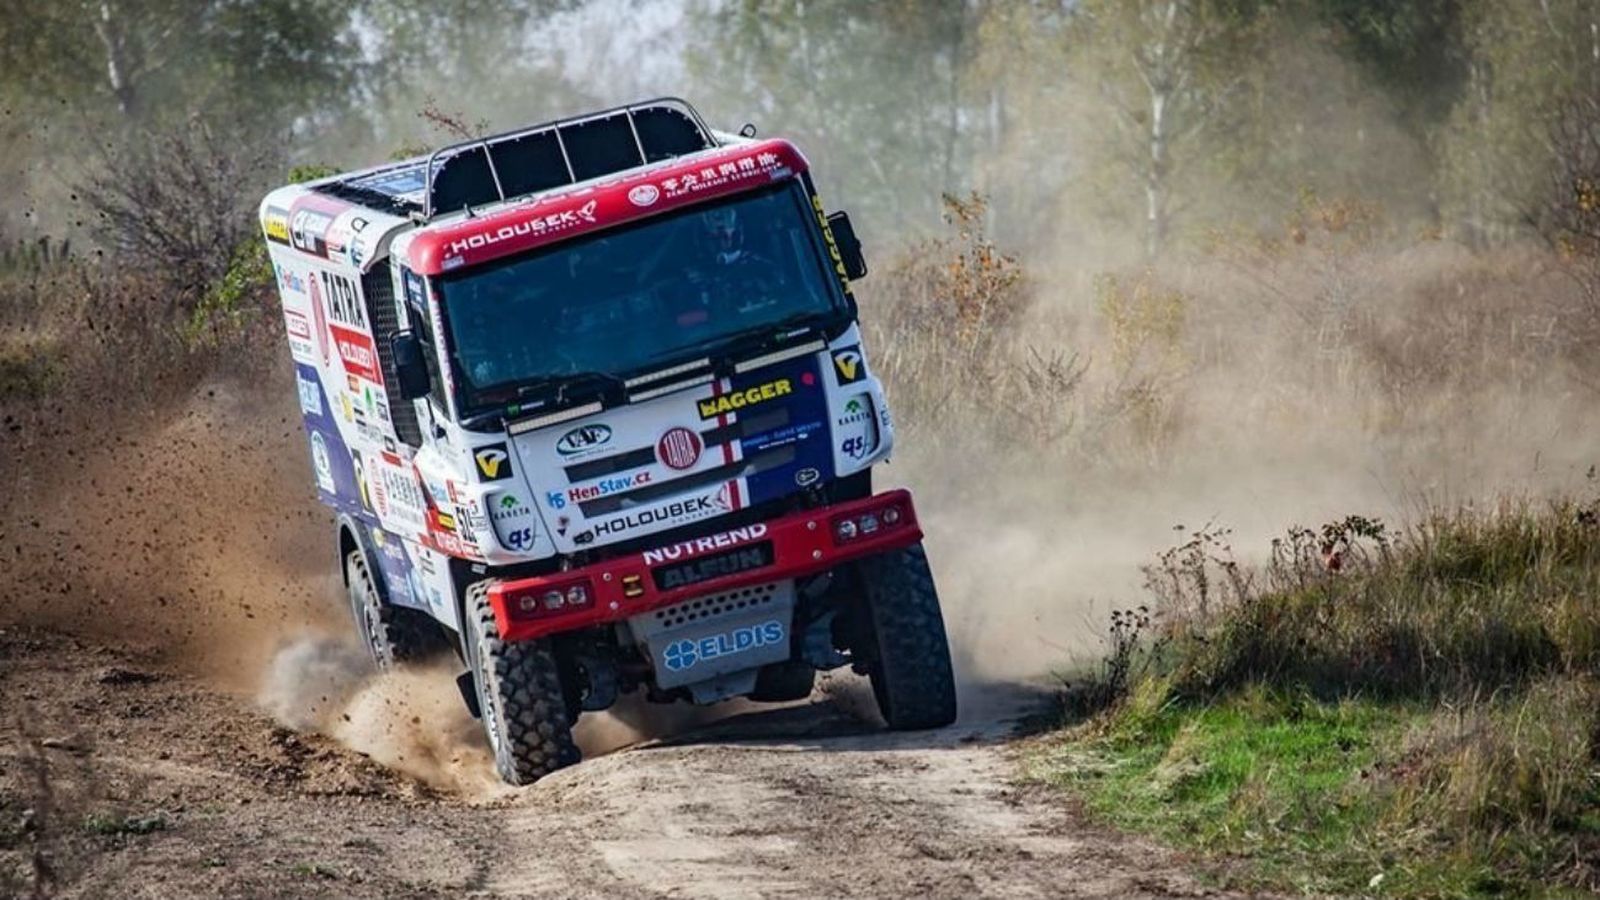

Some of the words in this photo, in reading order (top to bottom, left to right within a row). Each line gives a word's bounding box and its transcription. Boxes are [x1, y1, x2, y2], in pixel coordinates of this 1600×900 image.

[451, 210, 577, 253] HOLOUBEK
[321, 269, 366, 330] TATRA
[698, 377, 793, 418] BAGGER
[663, 430, 697, 467] TATRA
[594, 496, 712, 535] HOLOUBEK
[643, 523, 767, 566] NUTREND
[700, 620, 784, 665] ELDIS
